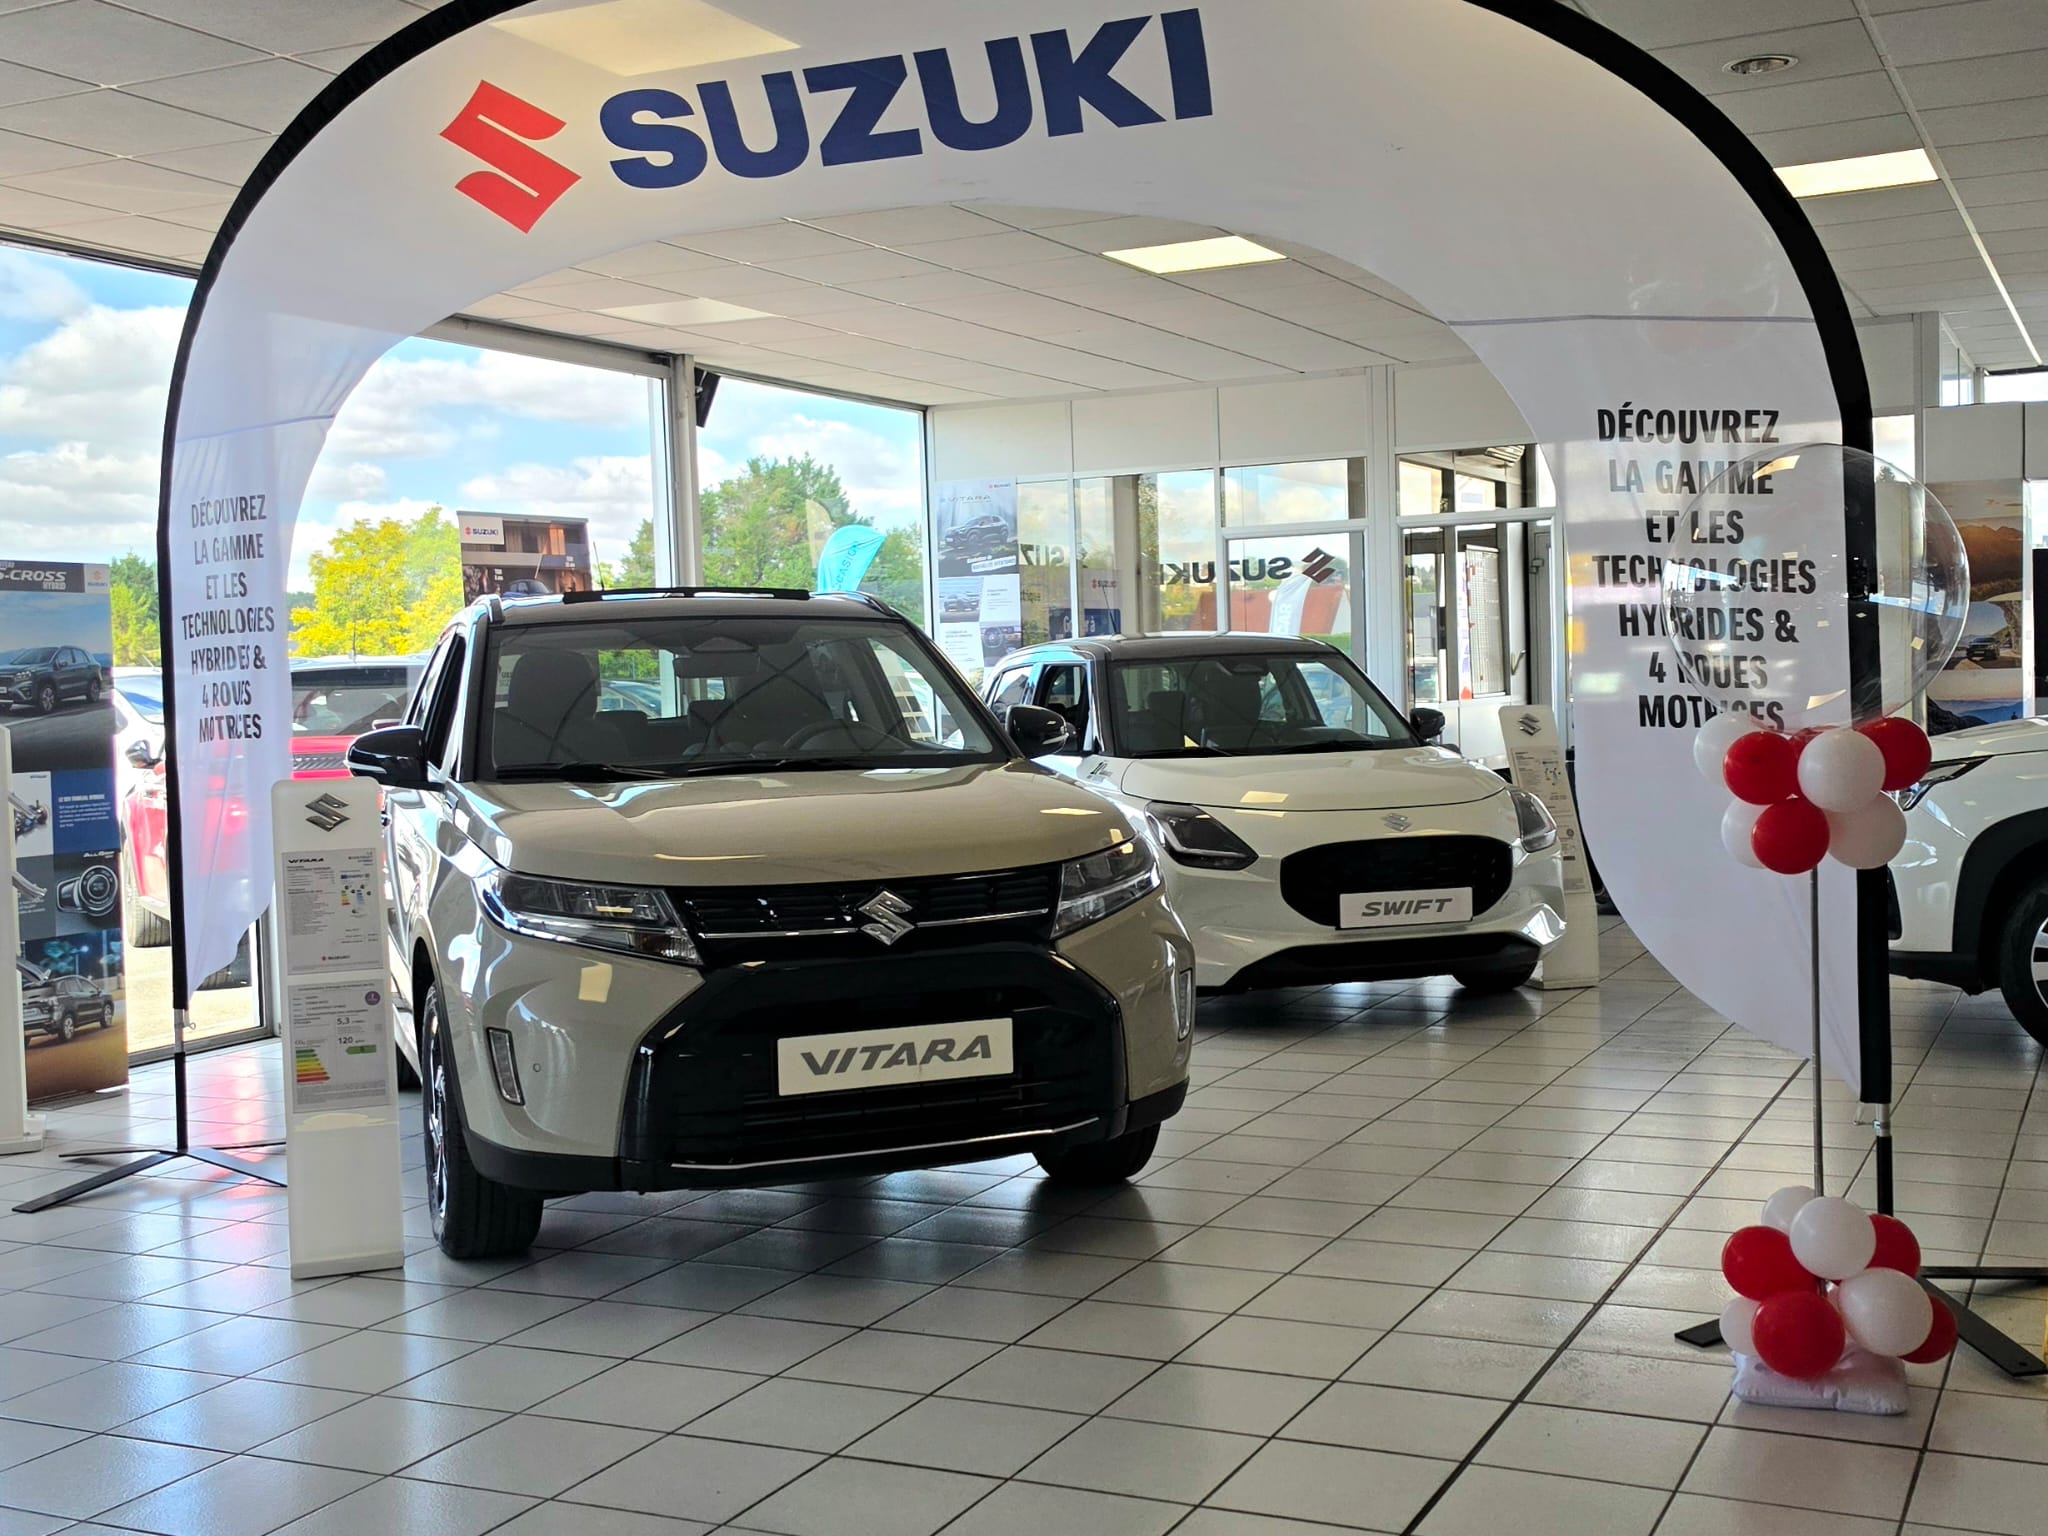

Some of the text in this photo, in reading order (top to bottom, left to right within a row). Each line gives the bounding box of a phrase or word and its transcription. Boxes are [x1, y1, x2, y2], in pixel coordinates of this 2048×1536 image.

[600, 8, 1213, 190] SUZUKI
[1597, 401, 1779, 443] DÉCOUVREZ
[1609, 459, 1774, 494] LA GAMME
[191, 495, 267, 528] DÉCOUVREZ
[1646, 510, 1744, 543] ET LES
[194, 533, 264, 565] LA GAMME
[206, 571, 247, 600] ET LES
[1592, 555, 1816, 594] TECHOLOGIES
[182, 606, 275, 640] TECHNOLOGIES
[1619, 604, 1799, 643] HYBRIDES &
[191, 645, 267, 675] HYBRIDES &
[1649, 651, 1768, 689] 4 ROUES
[202, 684, 208, 708] 4
[1361, 898, 1453, 917] SWIFT
[338, 1036, 354, 1045] 120
[800, 1034, 992, 1076] VITARA
